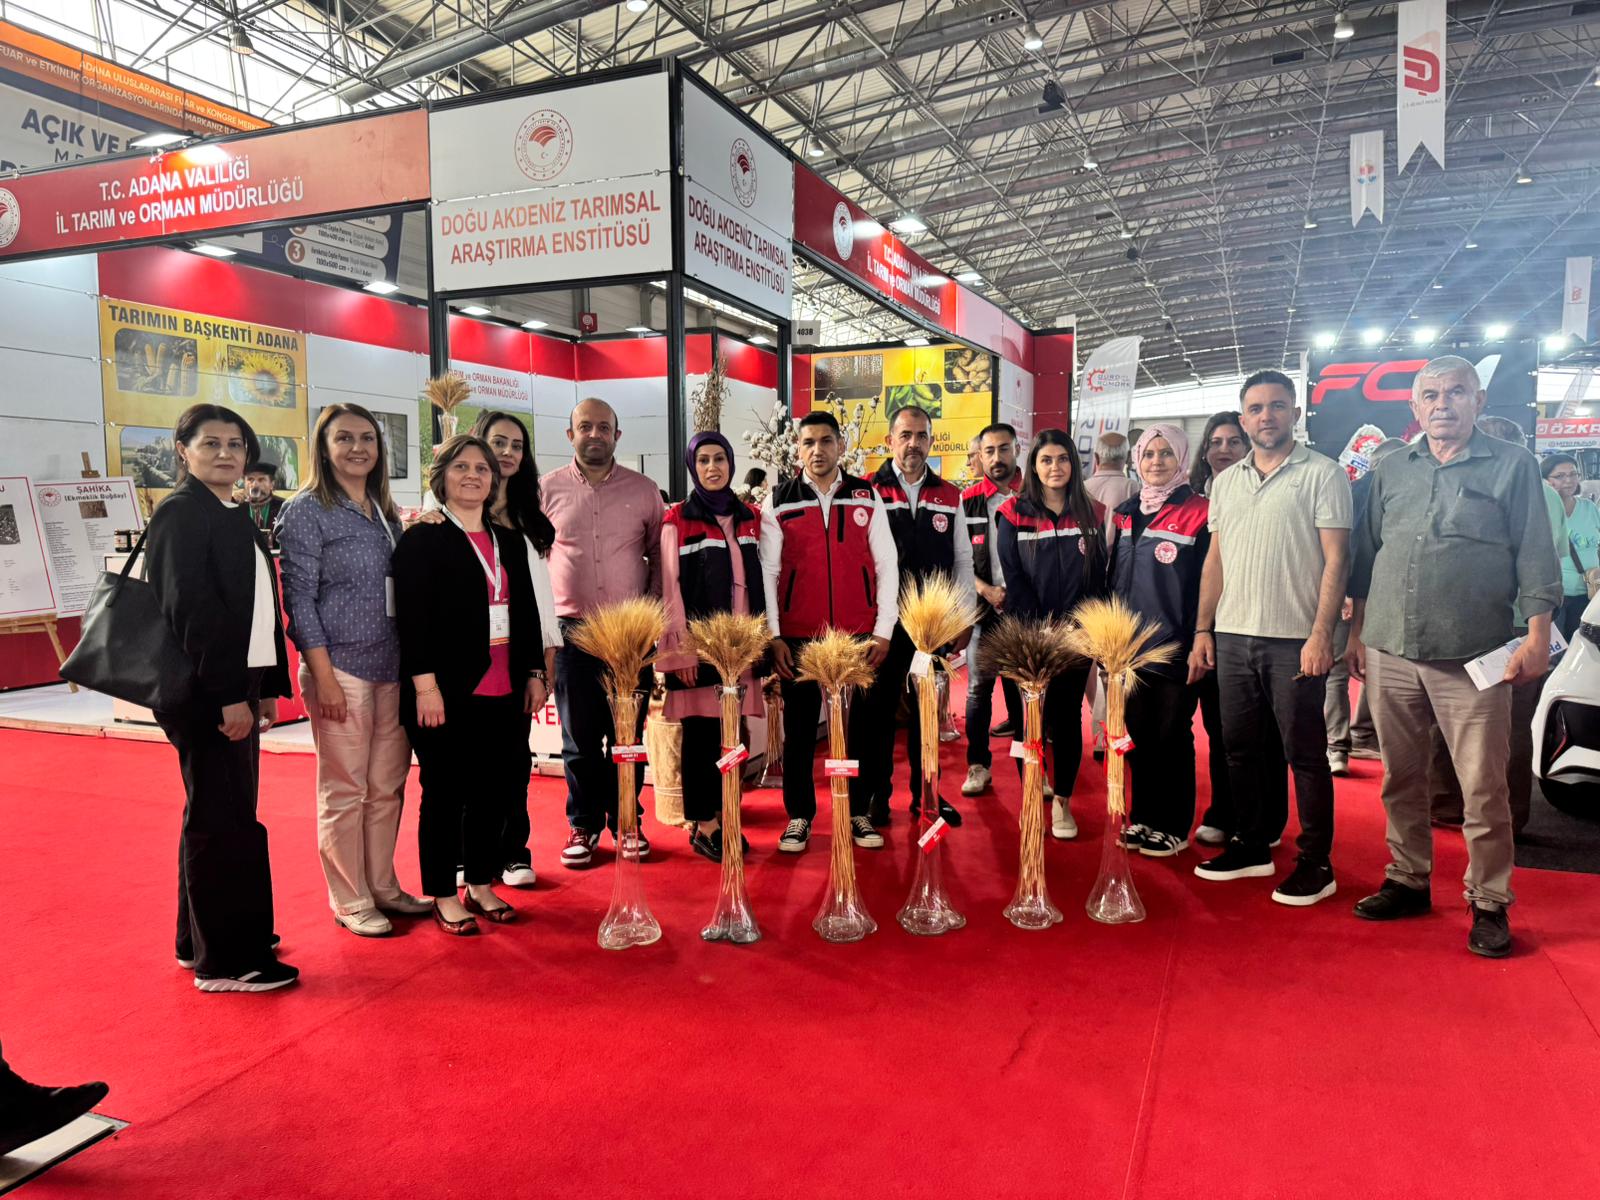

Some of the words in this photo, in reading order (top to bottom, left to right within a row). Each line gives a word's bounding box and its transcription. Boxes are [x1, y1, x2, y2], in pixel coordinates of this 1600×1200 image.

[79, 60, 111, 78] ADANA
[21, 108, 85, 147] AÇIK
[91, 128, 119, 154] VE
[56, 211, 69, 234] İL
[72, 207, 116, 232] TARIM
[119, 210, 136, 225] ve
[139, 196, 196, 223] ORMAN
[199, 176, 304, 215] MÜDÜRLÜĞÜ
[99, 180, 126, 201] T.C.
[128, 170, 182, 198] ADANA
[441, 208, 488, 236] DOĞU
[492, 197, 566, 230] AKDENİZ
[570, 190, 661, 221] TARIMSAL
[688, 195, 716, 229] DOĞU
[717, 213, 752, 250] AKDENİZ
[754, 233, 789, 271] TARIMSAL
[292, 243, 301, 260] 3
[450, 235, 548, 266] ARAŞTIRMA
[552, 217, 650, 254] ENSTİTÜSÜ
[694, 230, 744, 276] ARAŞTIRMA
[746, 257, 785, 294] ENSTİTÜSÜ
[108, 304, 178, 331] TARIMIN
[183, 318, 252, 343] BAŞKENTİ
[256, 331, 299, 352] ADANA
[76, 484, 112, 494] ŞAHİKA
